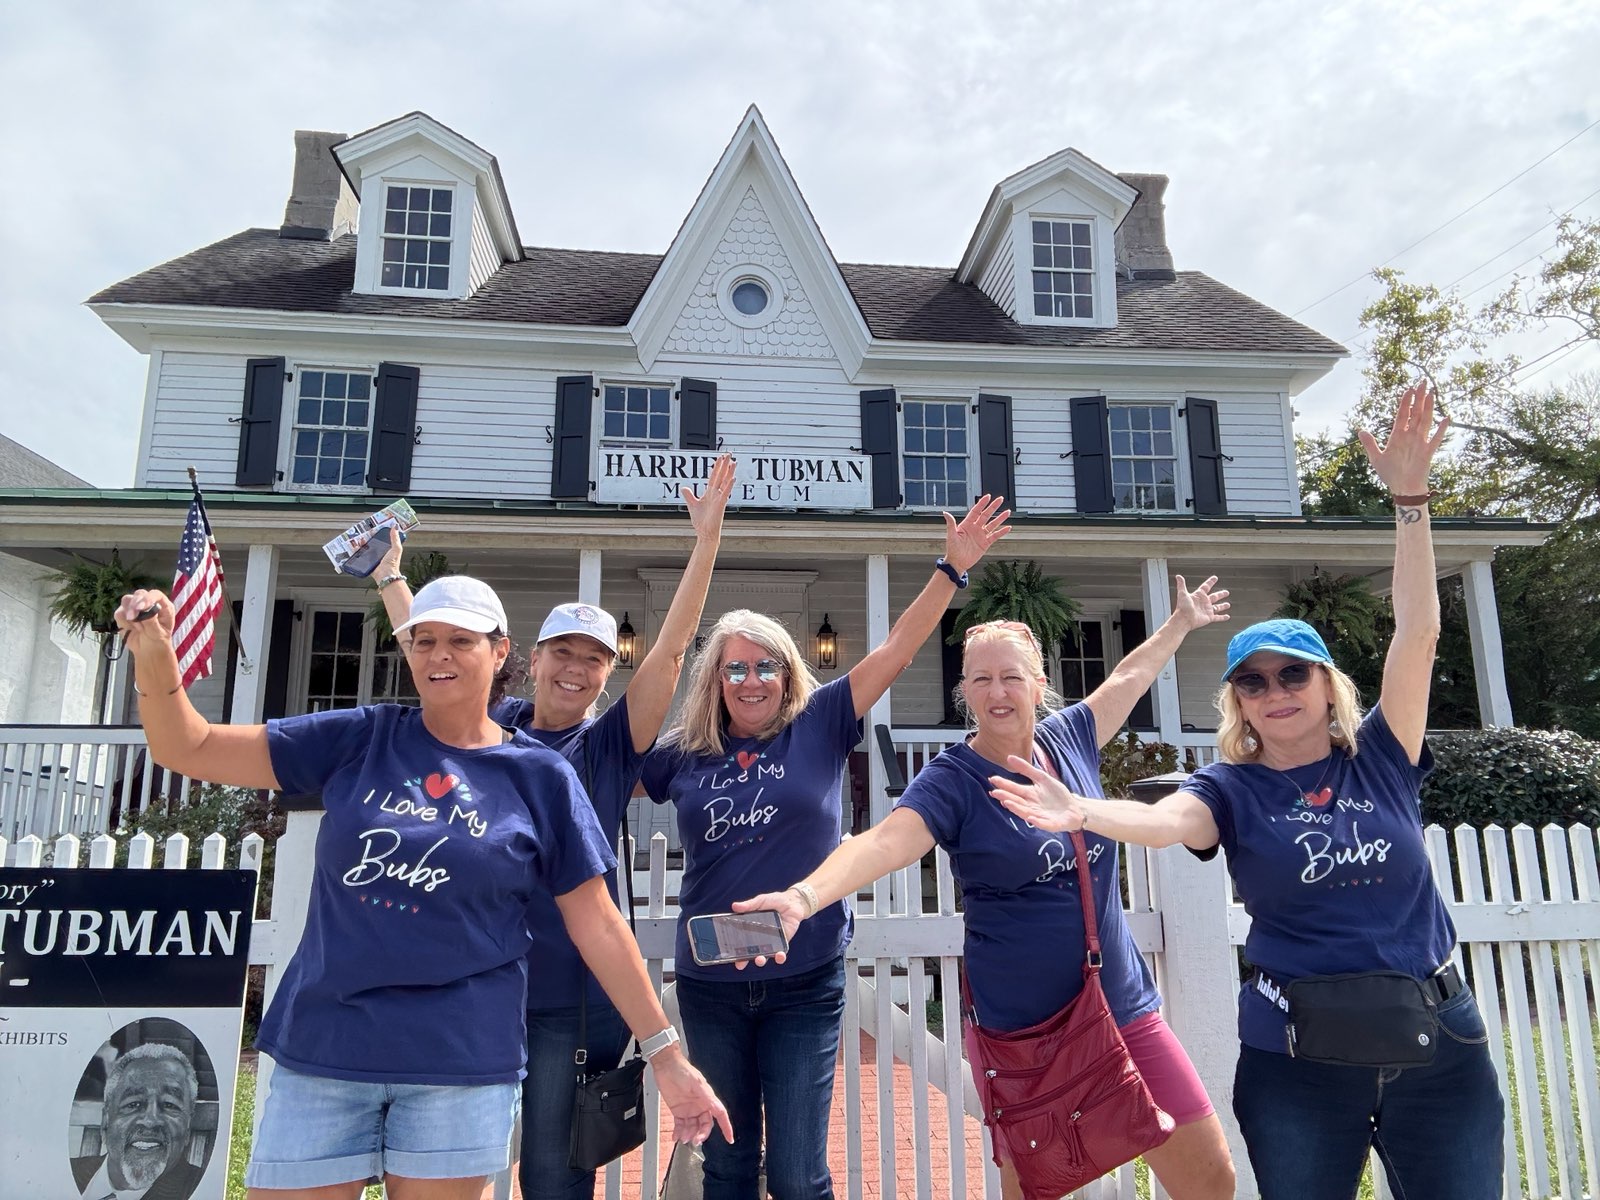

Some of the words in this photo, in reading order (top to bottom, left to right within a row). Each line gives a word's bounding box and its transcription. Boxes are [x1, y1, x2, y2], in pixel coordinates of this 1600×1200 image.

[604, 453, 737, 479] HARRIE
[751, 457, 864, 483] TUBMAN
[662, 482, 810, 502] MUEUM
[698, 775, 706, 789] I
[711, 769, 749, 790] Loe
[757, 763, 785, 780] My
[363, 788, 376, 805] I
[379, 791, 438, 822] Love
[448, 804, 488, 838] My
[703, 787, 779, 842] Bubs
[1336, 797, 1374, 812] My
[342, 828, 451, 892] Bubs
[1294, 821, 1392, 884] Bubs
[0, 909, 242, 956] TUBMAN
